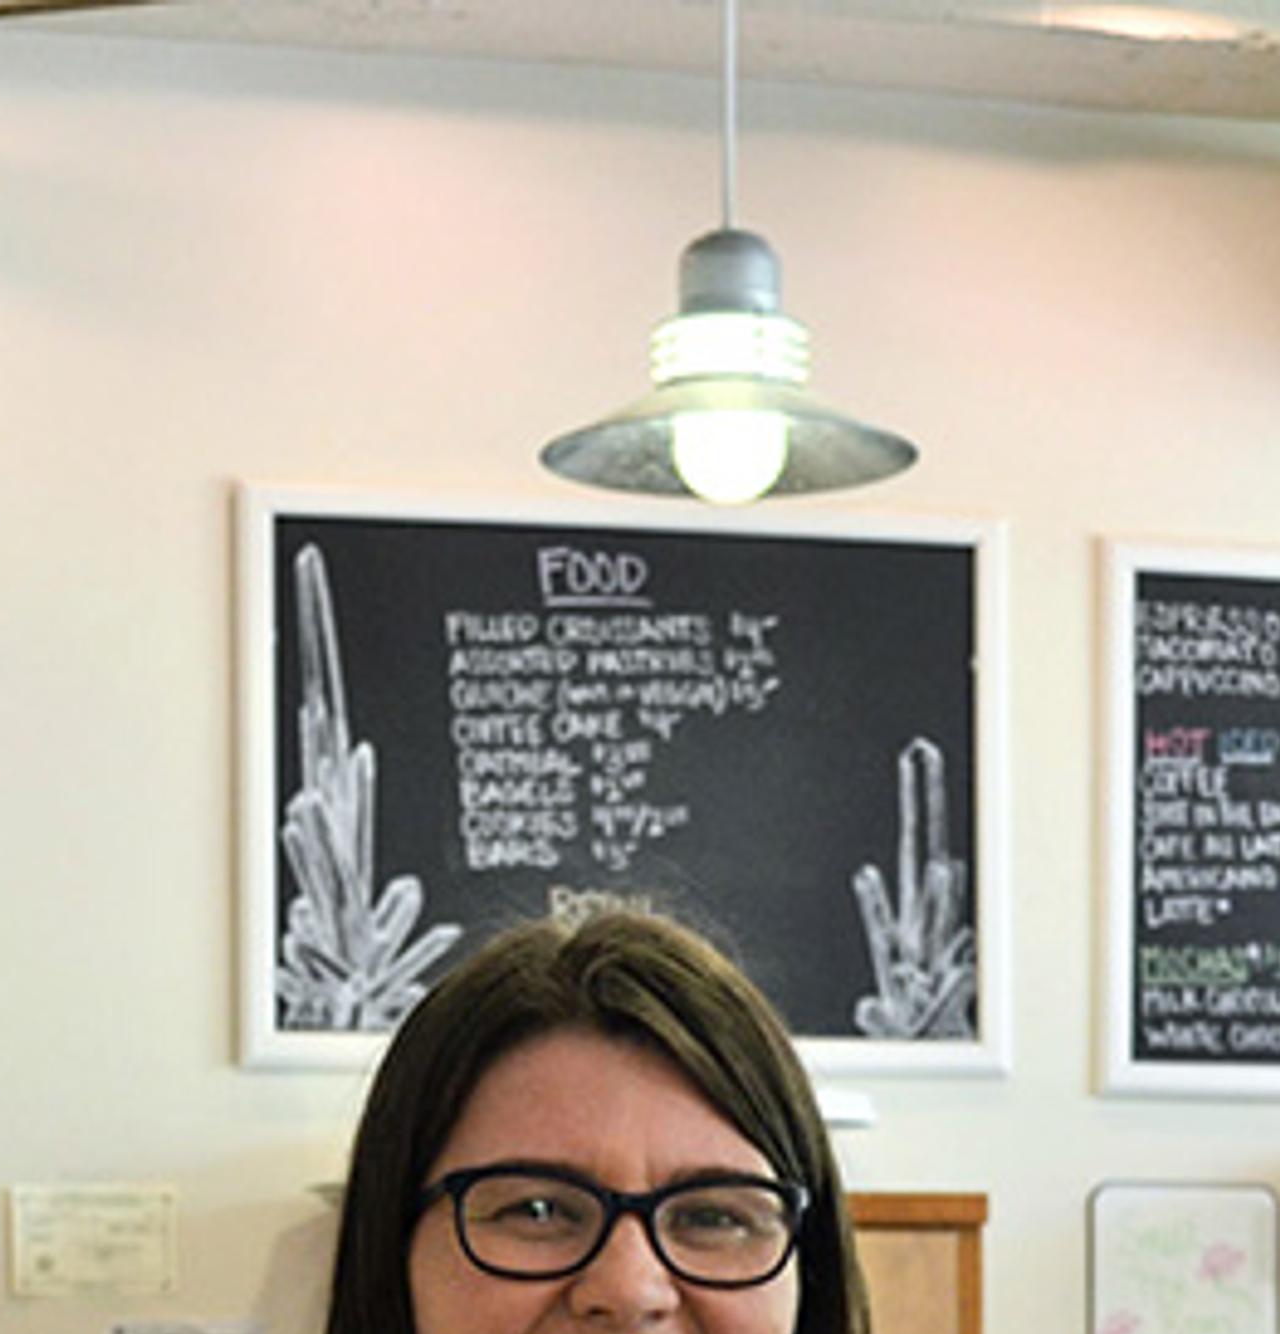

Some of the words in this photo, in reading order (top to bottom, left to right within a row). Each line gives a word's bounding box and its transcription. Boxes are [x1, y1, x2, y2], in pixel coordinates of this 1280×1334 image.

[537, 547, 648, 594] FOOD
[445, 611, 538, 645] FILLED
[451, 712, 542, 746] COFFEE
[552, 710, 621, 743] CAKE
[1144, 727, 1210, 758] HOT
[460, 778, 575, 808] BAGELS
[1141, 763, 1227, 798] COFFEE
[460, 809, 577, 840] COOKIES
[466, 839, 559, 870] BARS
